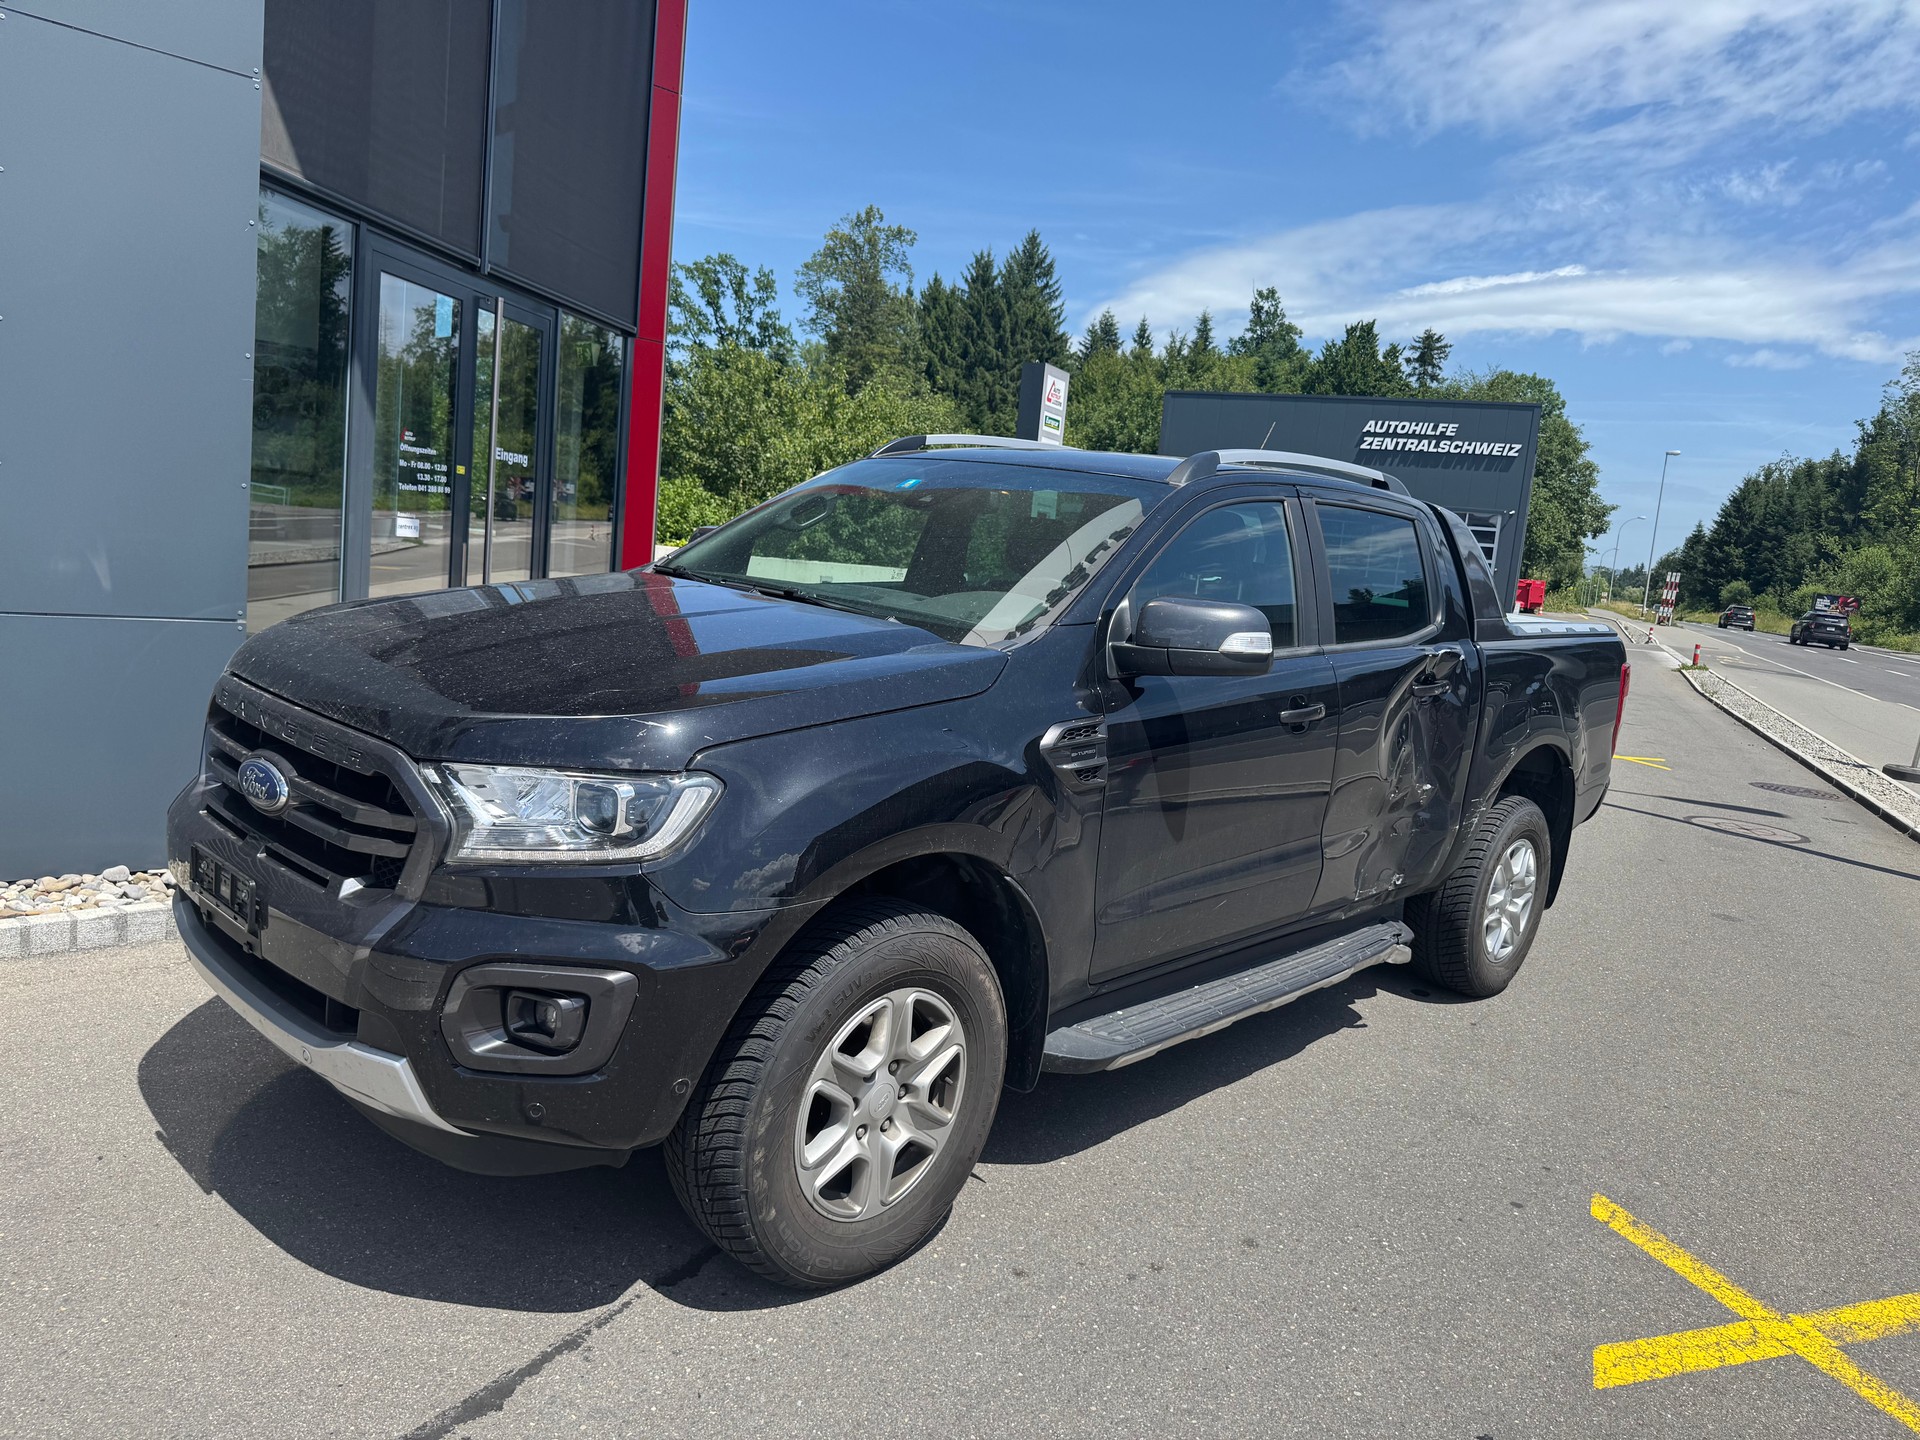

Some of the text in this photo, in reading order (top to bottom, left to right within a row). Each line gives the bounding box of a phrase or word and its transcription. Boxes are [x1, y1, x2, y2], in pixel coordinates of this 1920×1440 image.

[1362, 420, 1459, 436] AUTOHILFE
[400, 442, 436, 455] Öffnungszeiten
[1359, 437, 1522, 457] ZENTRALSCHWEIZ
[399, 459, 407, 467] Mo
[495, 447, 528, 467] Eingang
[417, 473, 430, 481] 13.30
[434, 475, 447, 483] 17.00
[399, 482, 417, 491] Telefon
[243, 766, 270, 800] Ford
